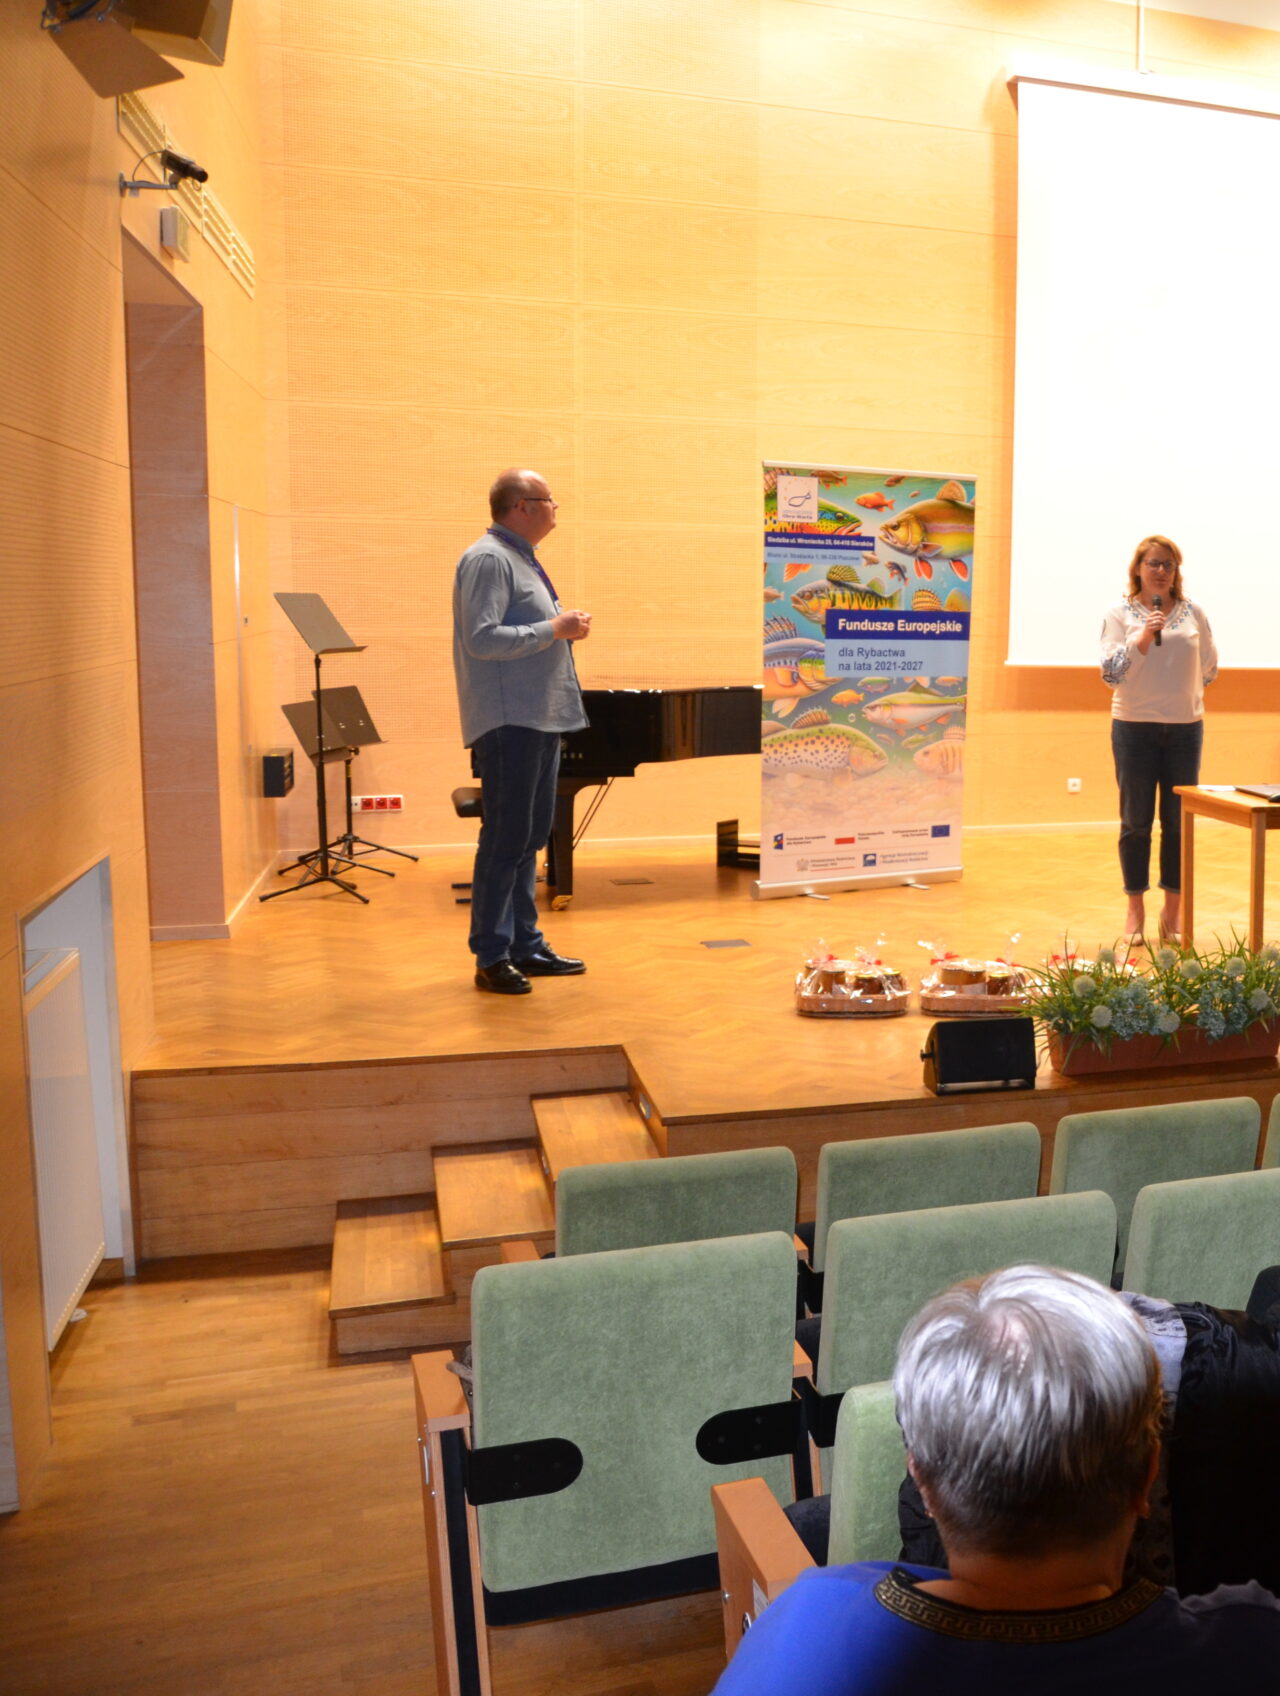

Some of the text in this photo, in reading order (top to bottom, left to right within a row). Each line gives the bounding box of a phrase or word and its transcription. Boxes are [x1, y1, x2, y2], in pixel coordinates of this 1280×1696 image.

[838, 618, 962, 634] Fundusze Europejskie
[838, 648, 906, 659] dla Rybactwa
[838, 661, 923, 671] na lata 2021-2027
